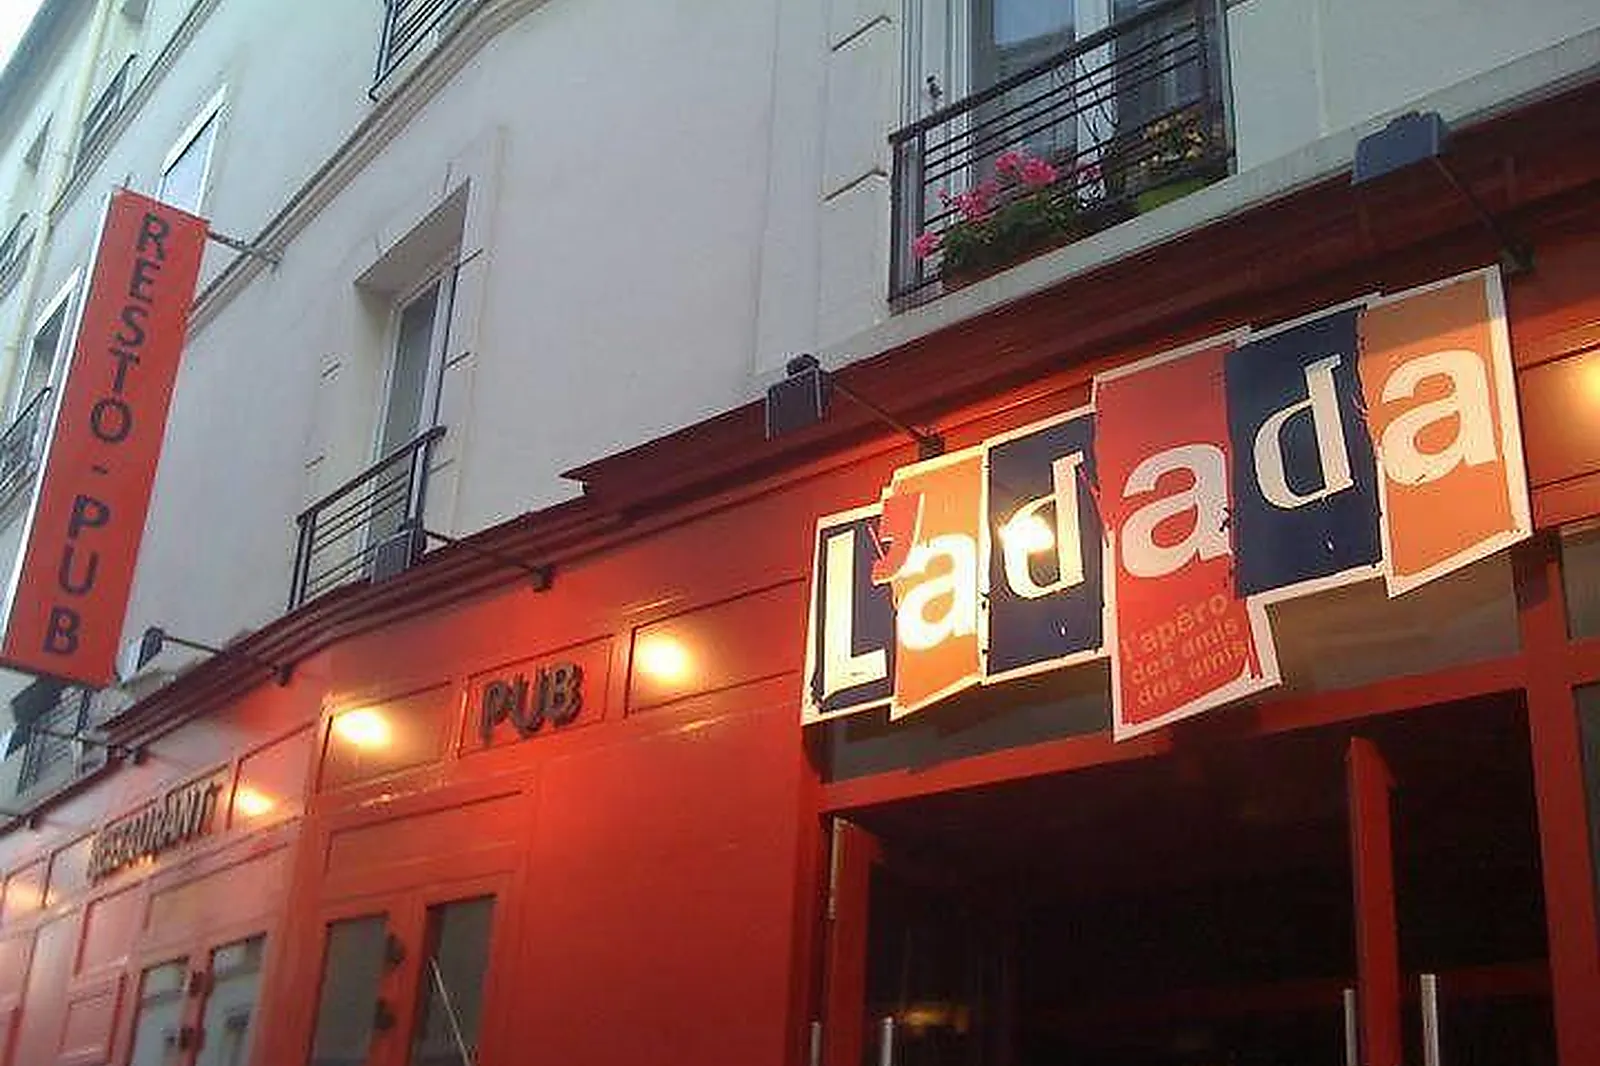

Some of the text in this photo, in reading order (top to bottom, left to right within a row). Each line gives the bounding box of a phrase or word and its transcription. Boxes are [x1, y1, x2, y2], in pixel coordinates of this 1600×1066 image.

[43, 494, 109, 656] PUB
[480, 661, 583, 747] PUB
[87, 781, 222, 885] URANT
